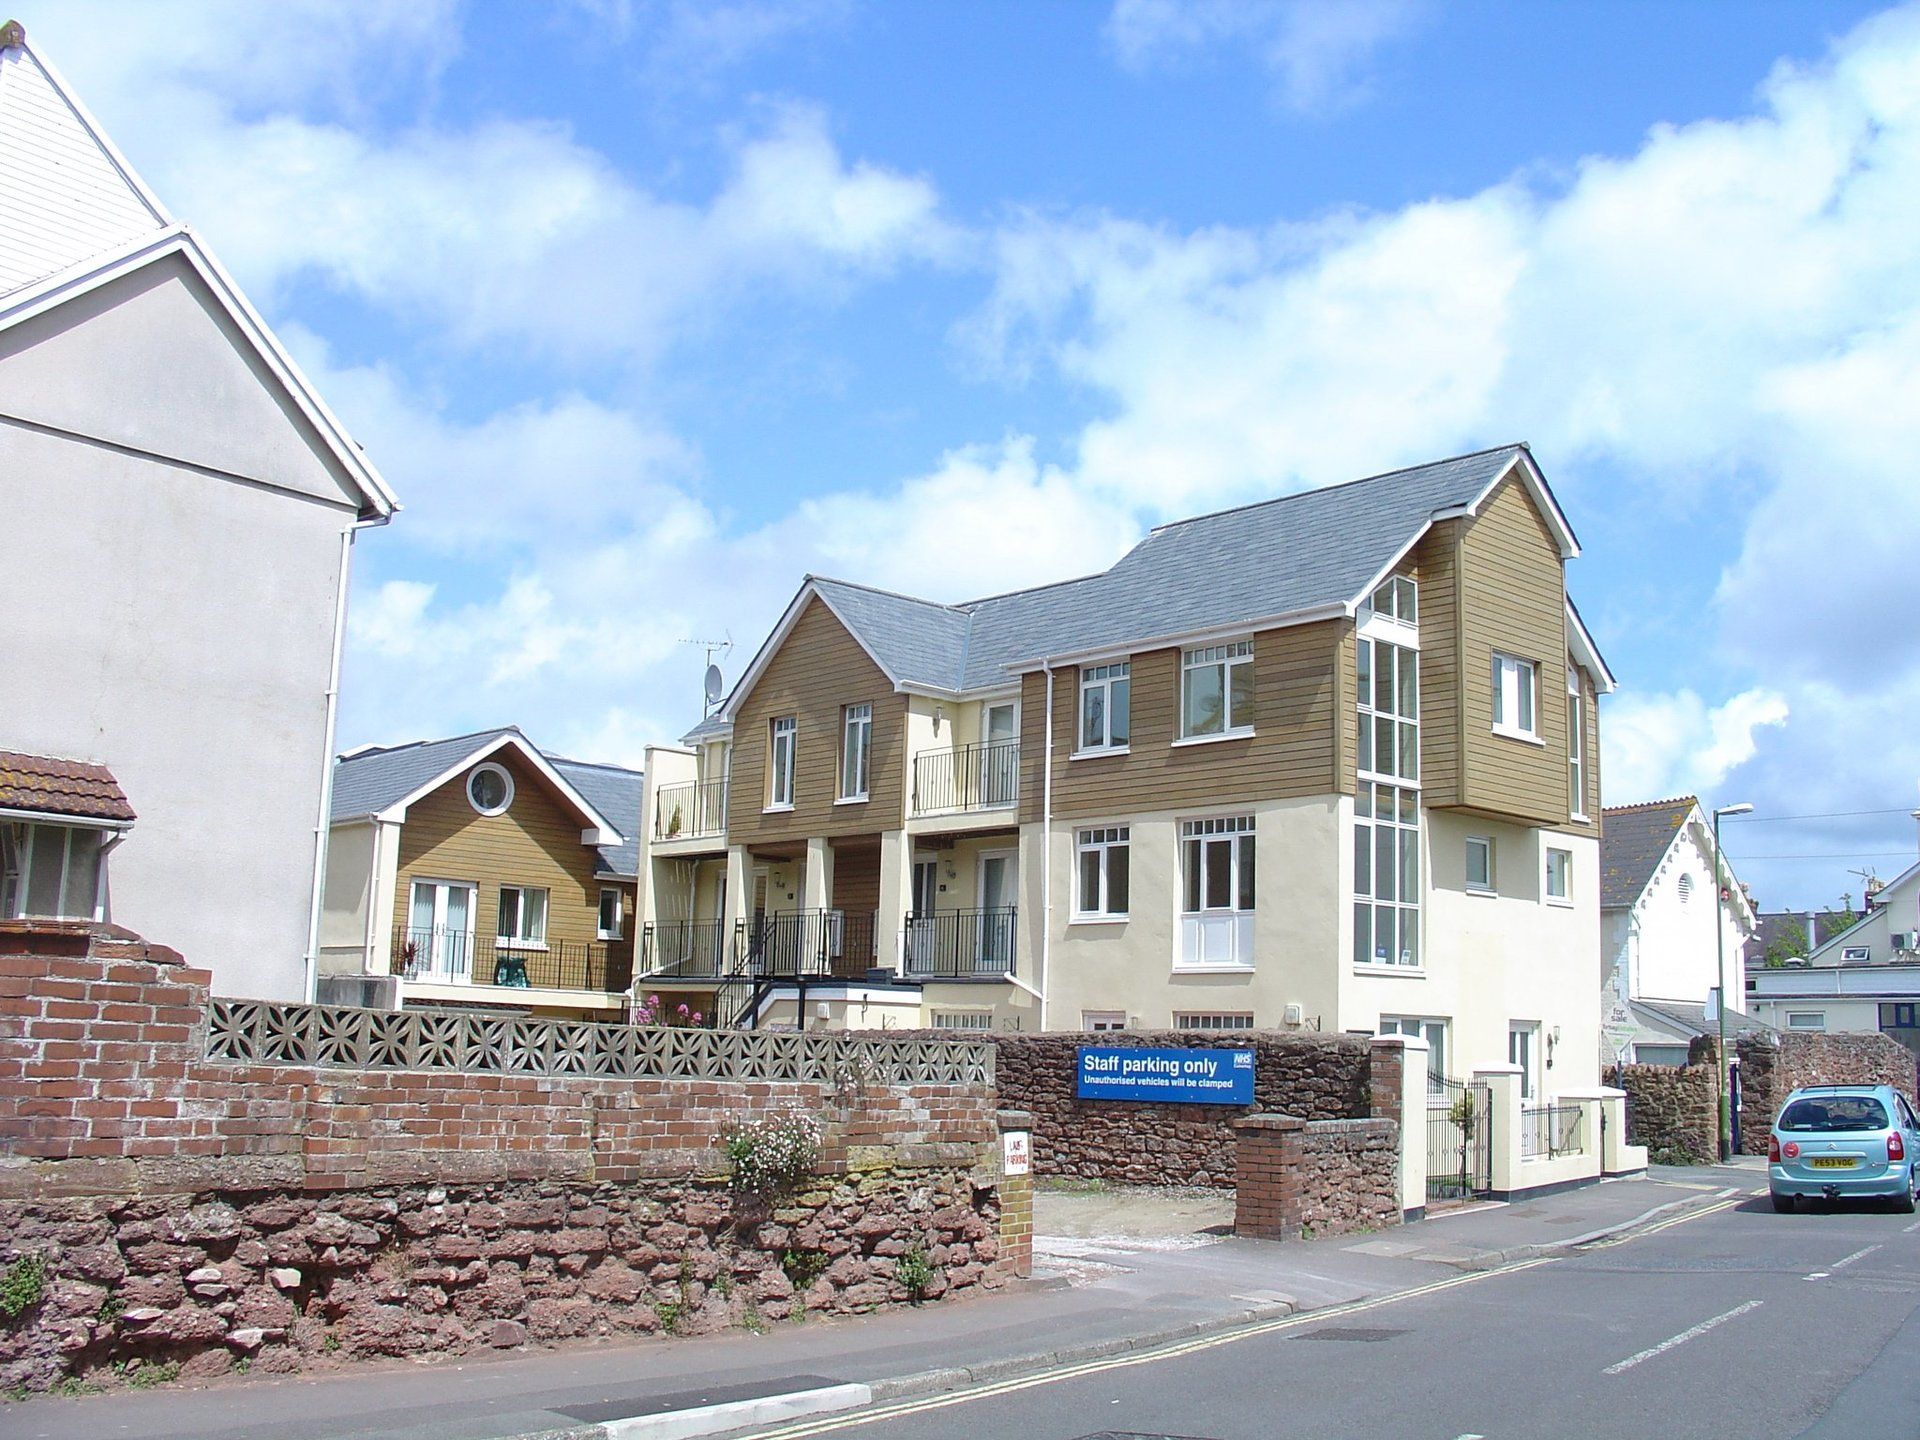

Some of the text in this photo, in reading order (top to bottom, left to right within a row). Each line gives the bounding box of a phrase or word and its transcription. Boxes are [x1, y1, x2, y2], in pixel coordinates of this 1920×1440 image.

[1613, 1007, 1625, 1016] for
[1611, 1014, 1628, 1022] sale
[1084, 1055, 1217, 1077] Staff parking only
[1084, 1075, 1233, 1090] Unauthorised vehicles will be clamped
